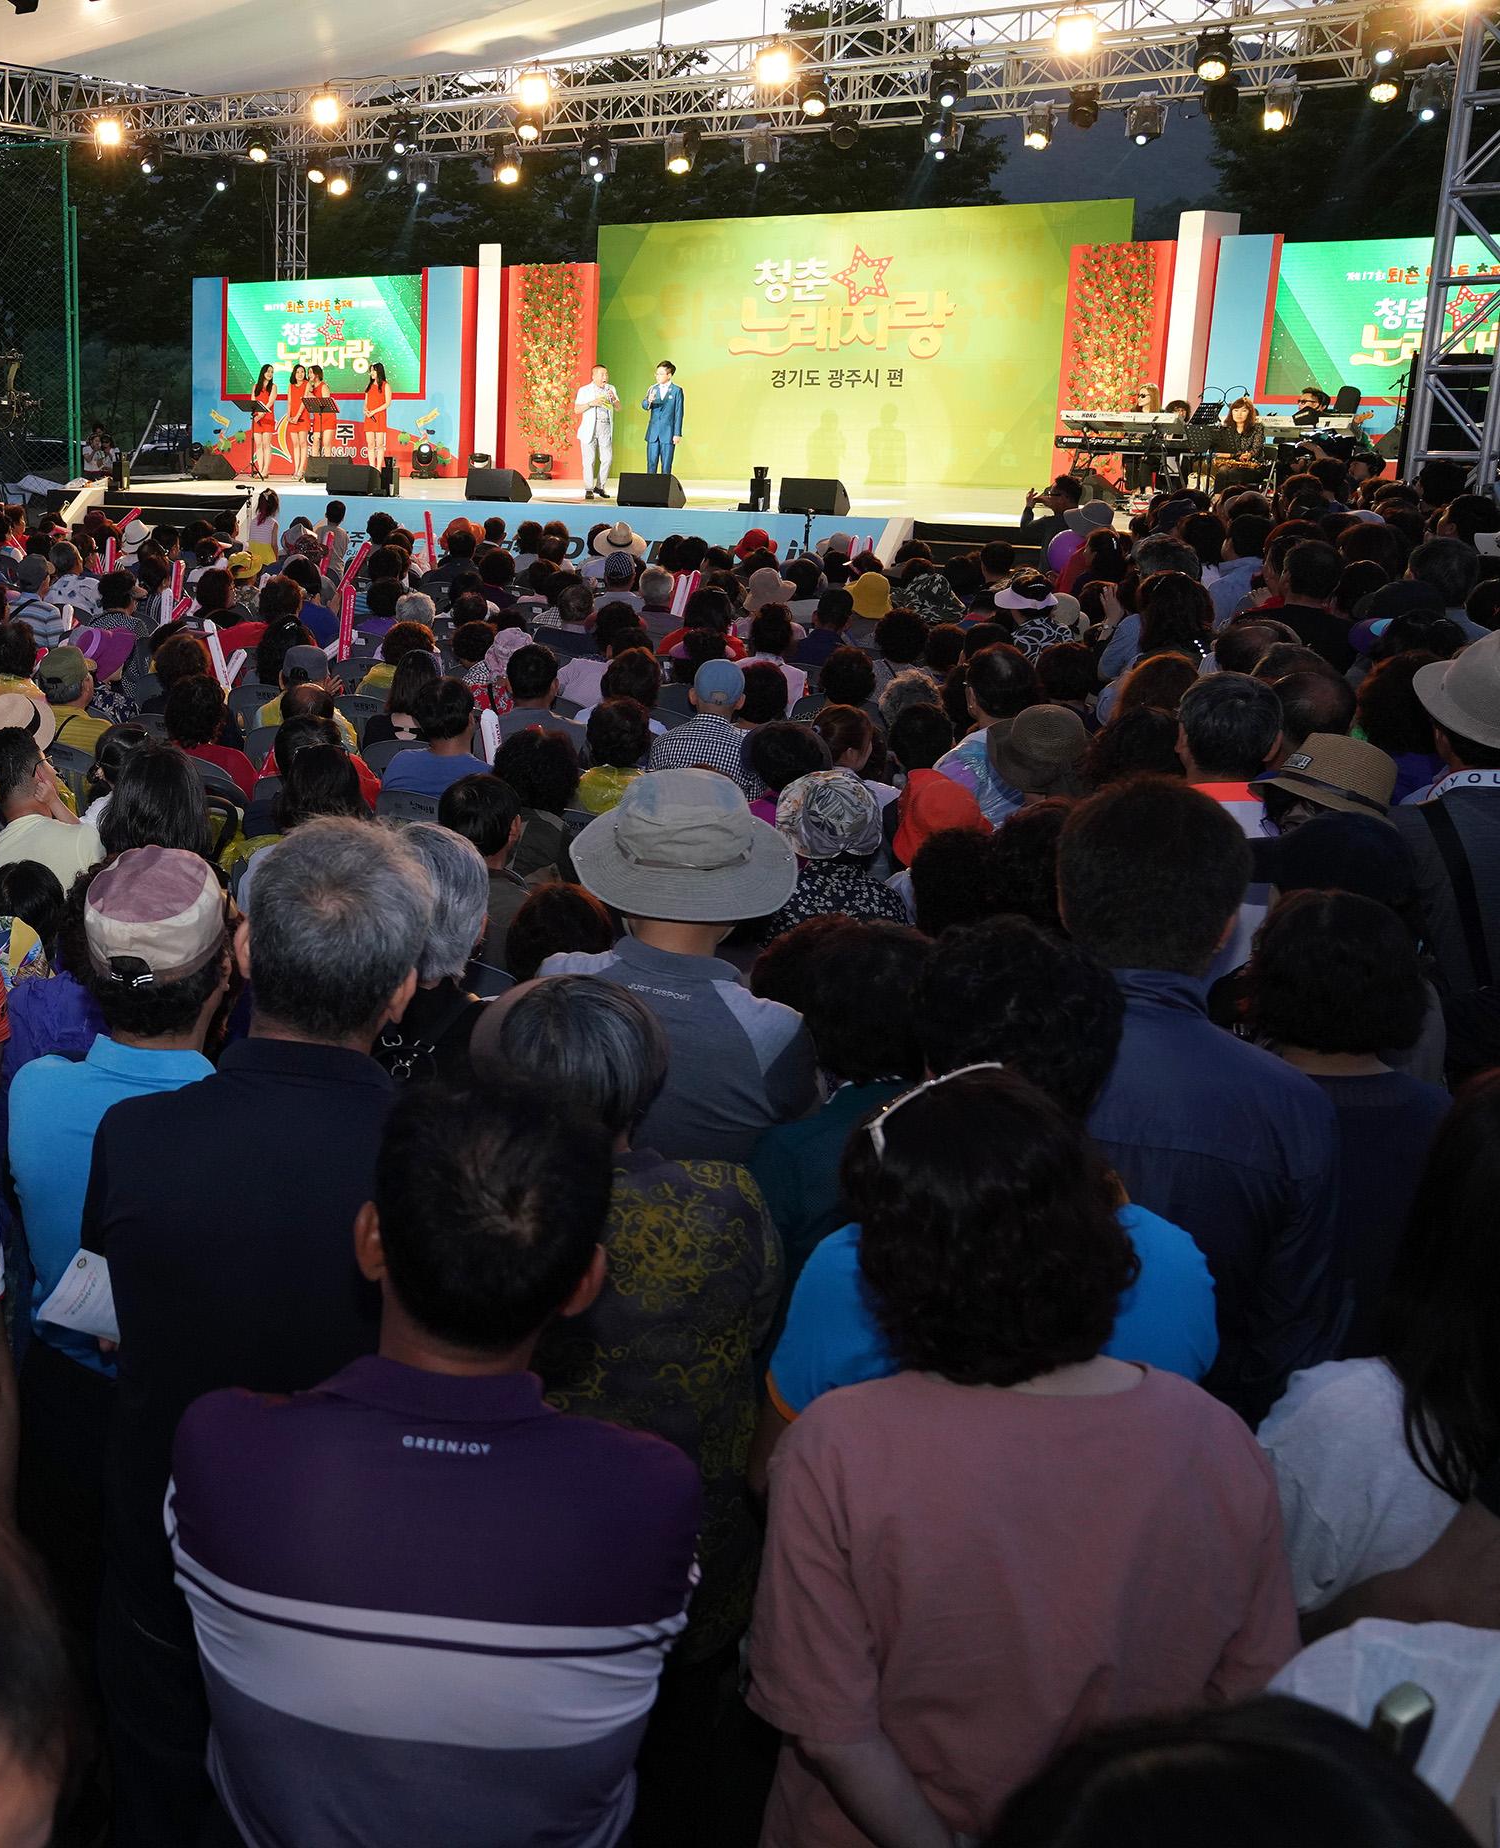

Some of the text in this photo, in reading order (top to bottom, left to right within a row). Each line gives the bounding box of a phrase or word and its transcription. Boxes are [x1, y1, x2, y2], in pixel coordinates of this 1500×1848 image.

[753, 257, 832, 304] 청춘
[307, 298, 332, 313] 토마토
[282, 321, 318, 346] 청춘
[728, 288, 957, 361] 노래자랑
[273, 338, 375, 375] 노래자랑
[770, 367, 821, 389] 경기도
[827, 367, 880, 389] 광주시
[886, 367, 905, 389] 편
[1081, 412, 1097, 420] KORG
[402, 1435, 490, 1455] GREENJOY
